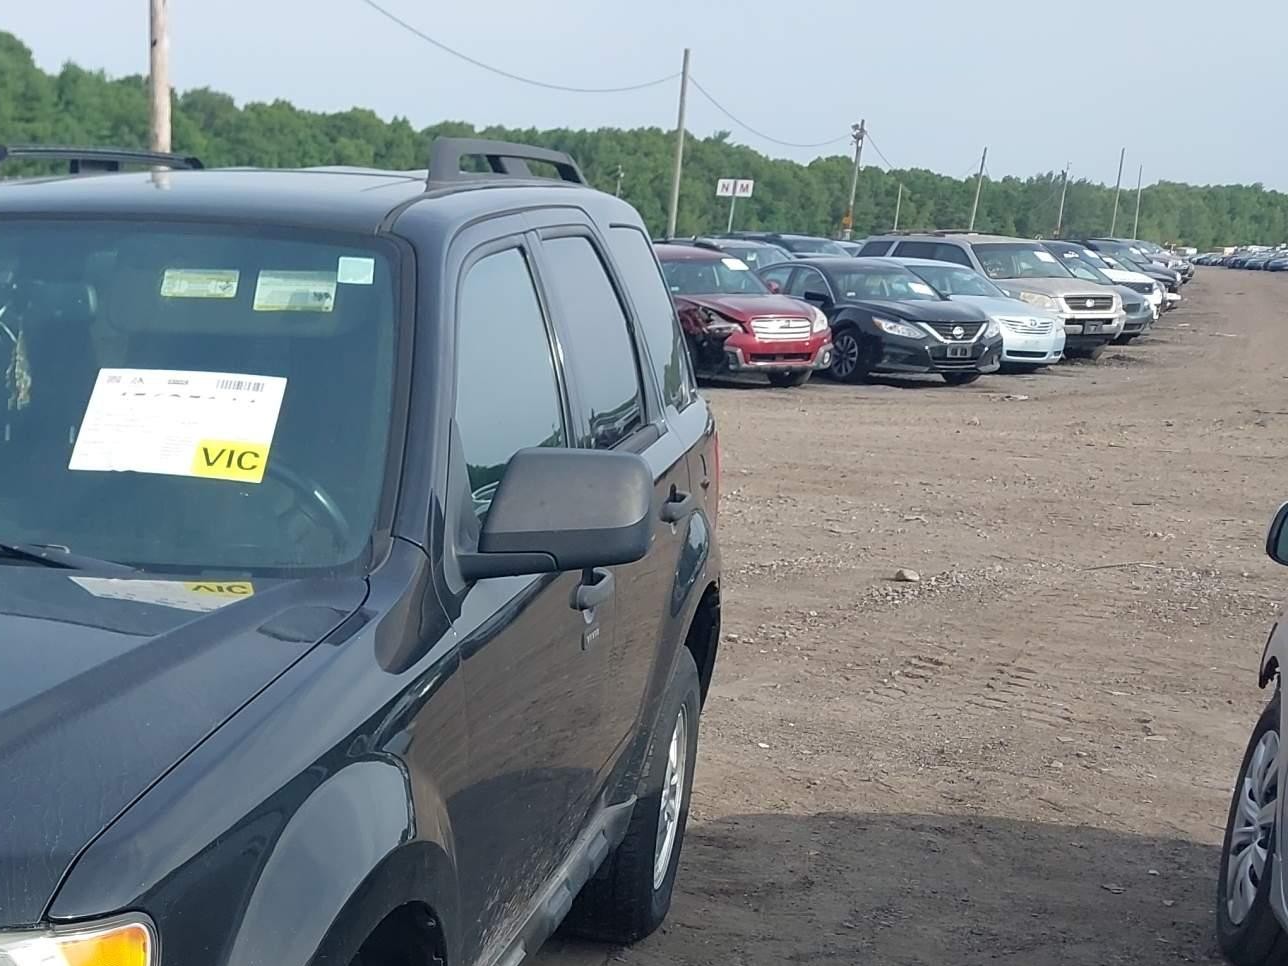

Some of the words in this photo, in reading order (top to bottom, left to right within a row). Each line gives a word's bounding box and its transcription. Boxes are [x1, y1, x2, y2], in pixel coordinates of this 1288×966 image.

[720, 183, 730, 193] N
[739, 183, 749, 193] M
[202, 447, 260, 471] VIC
